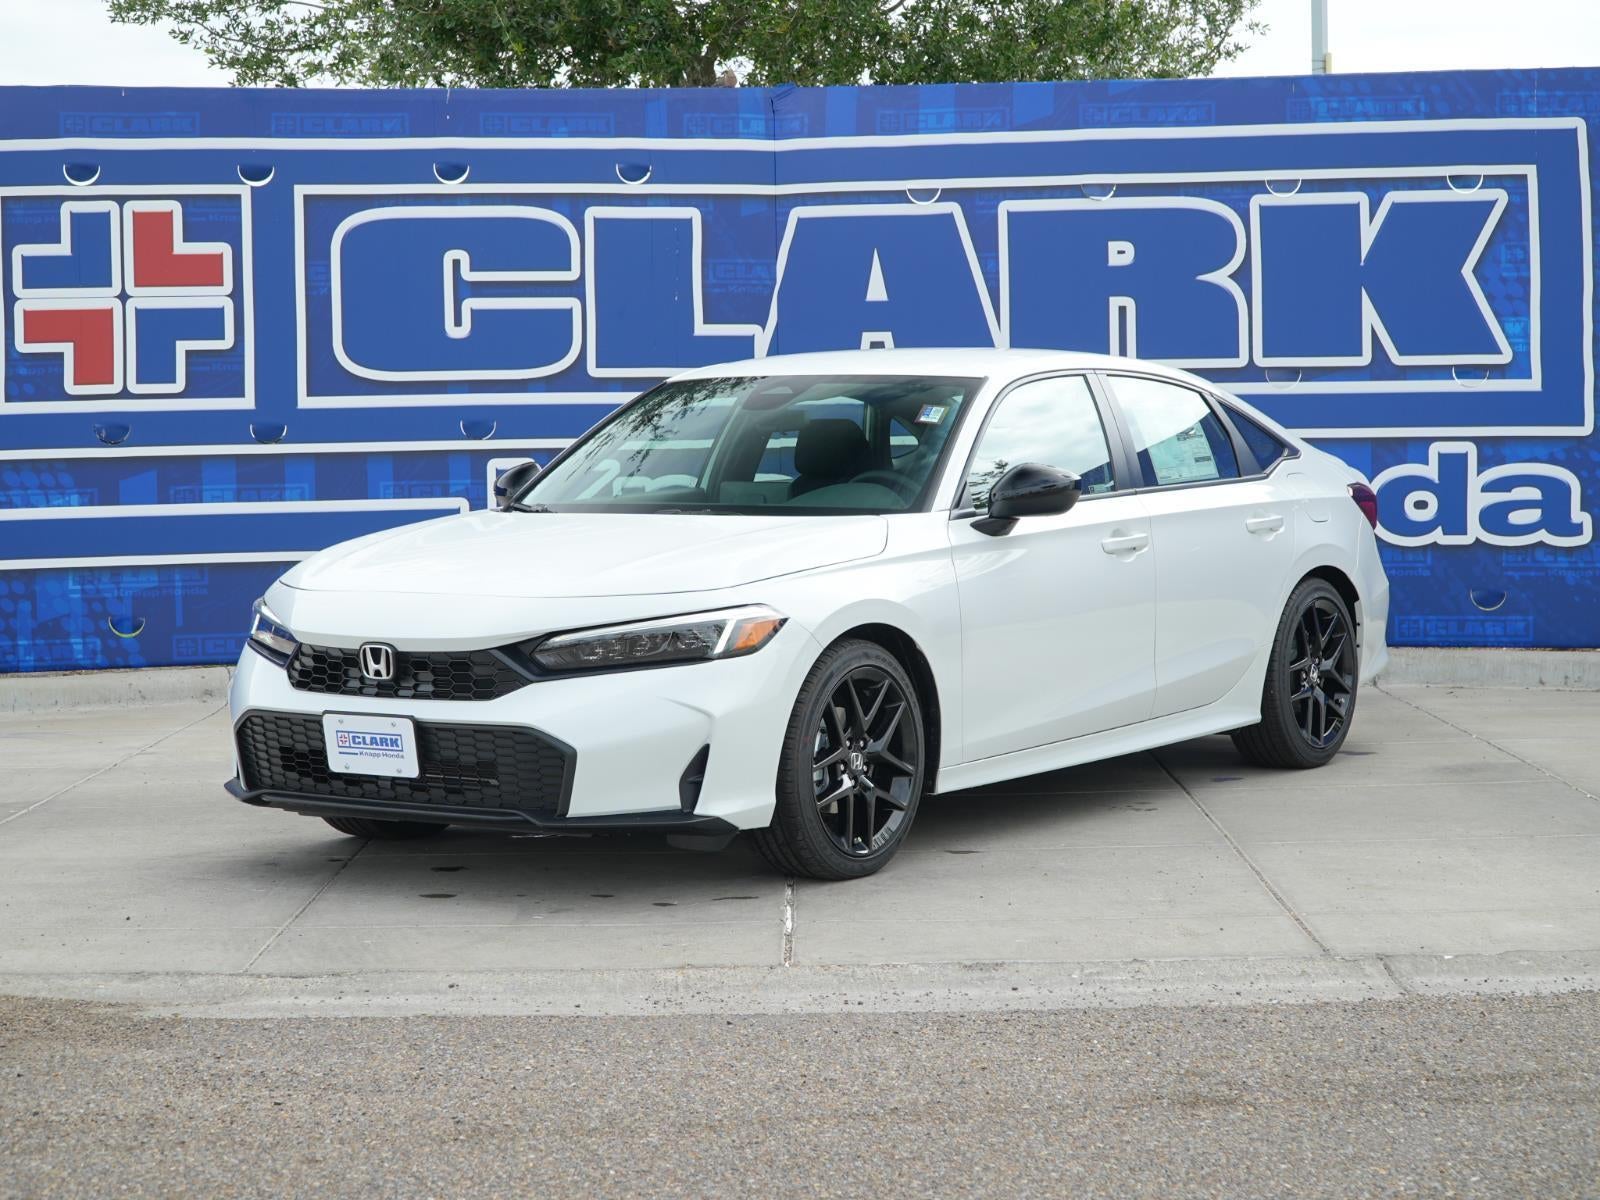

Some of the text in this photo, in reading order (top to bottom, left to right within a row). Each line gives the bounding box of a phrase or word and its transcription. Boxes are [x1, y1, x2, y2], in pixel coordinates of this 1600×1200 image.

[331, 189, 1513, 382] CLARK
[351, 735, 400, 748] CLARK
[359, 750, 405, 760] Knapp Honda
